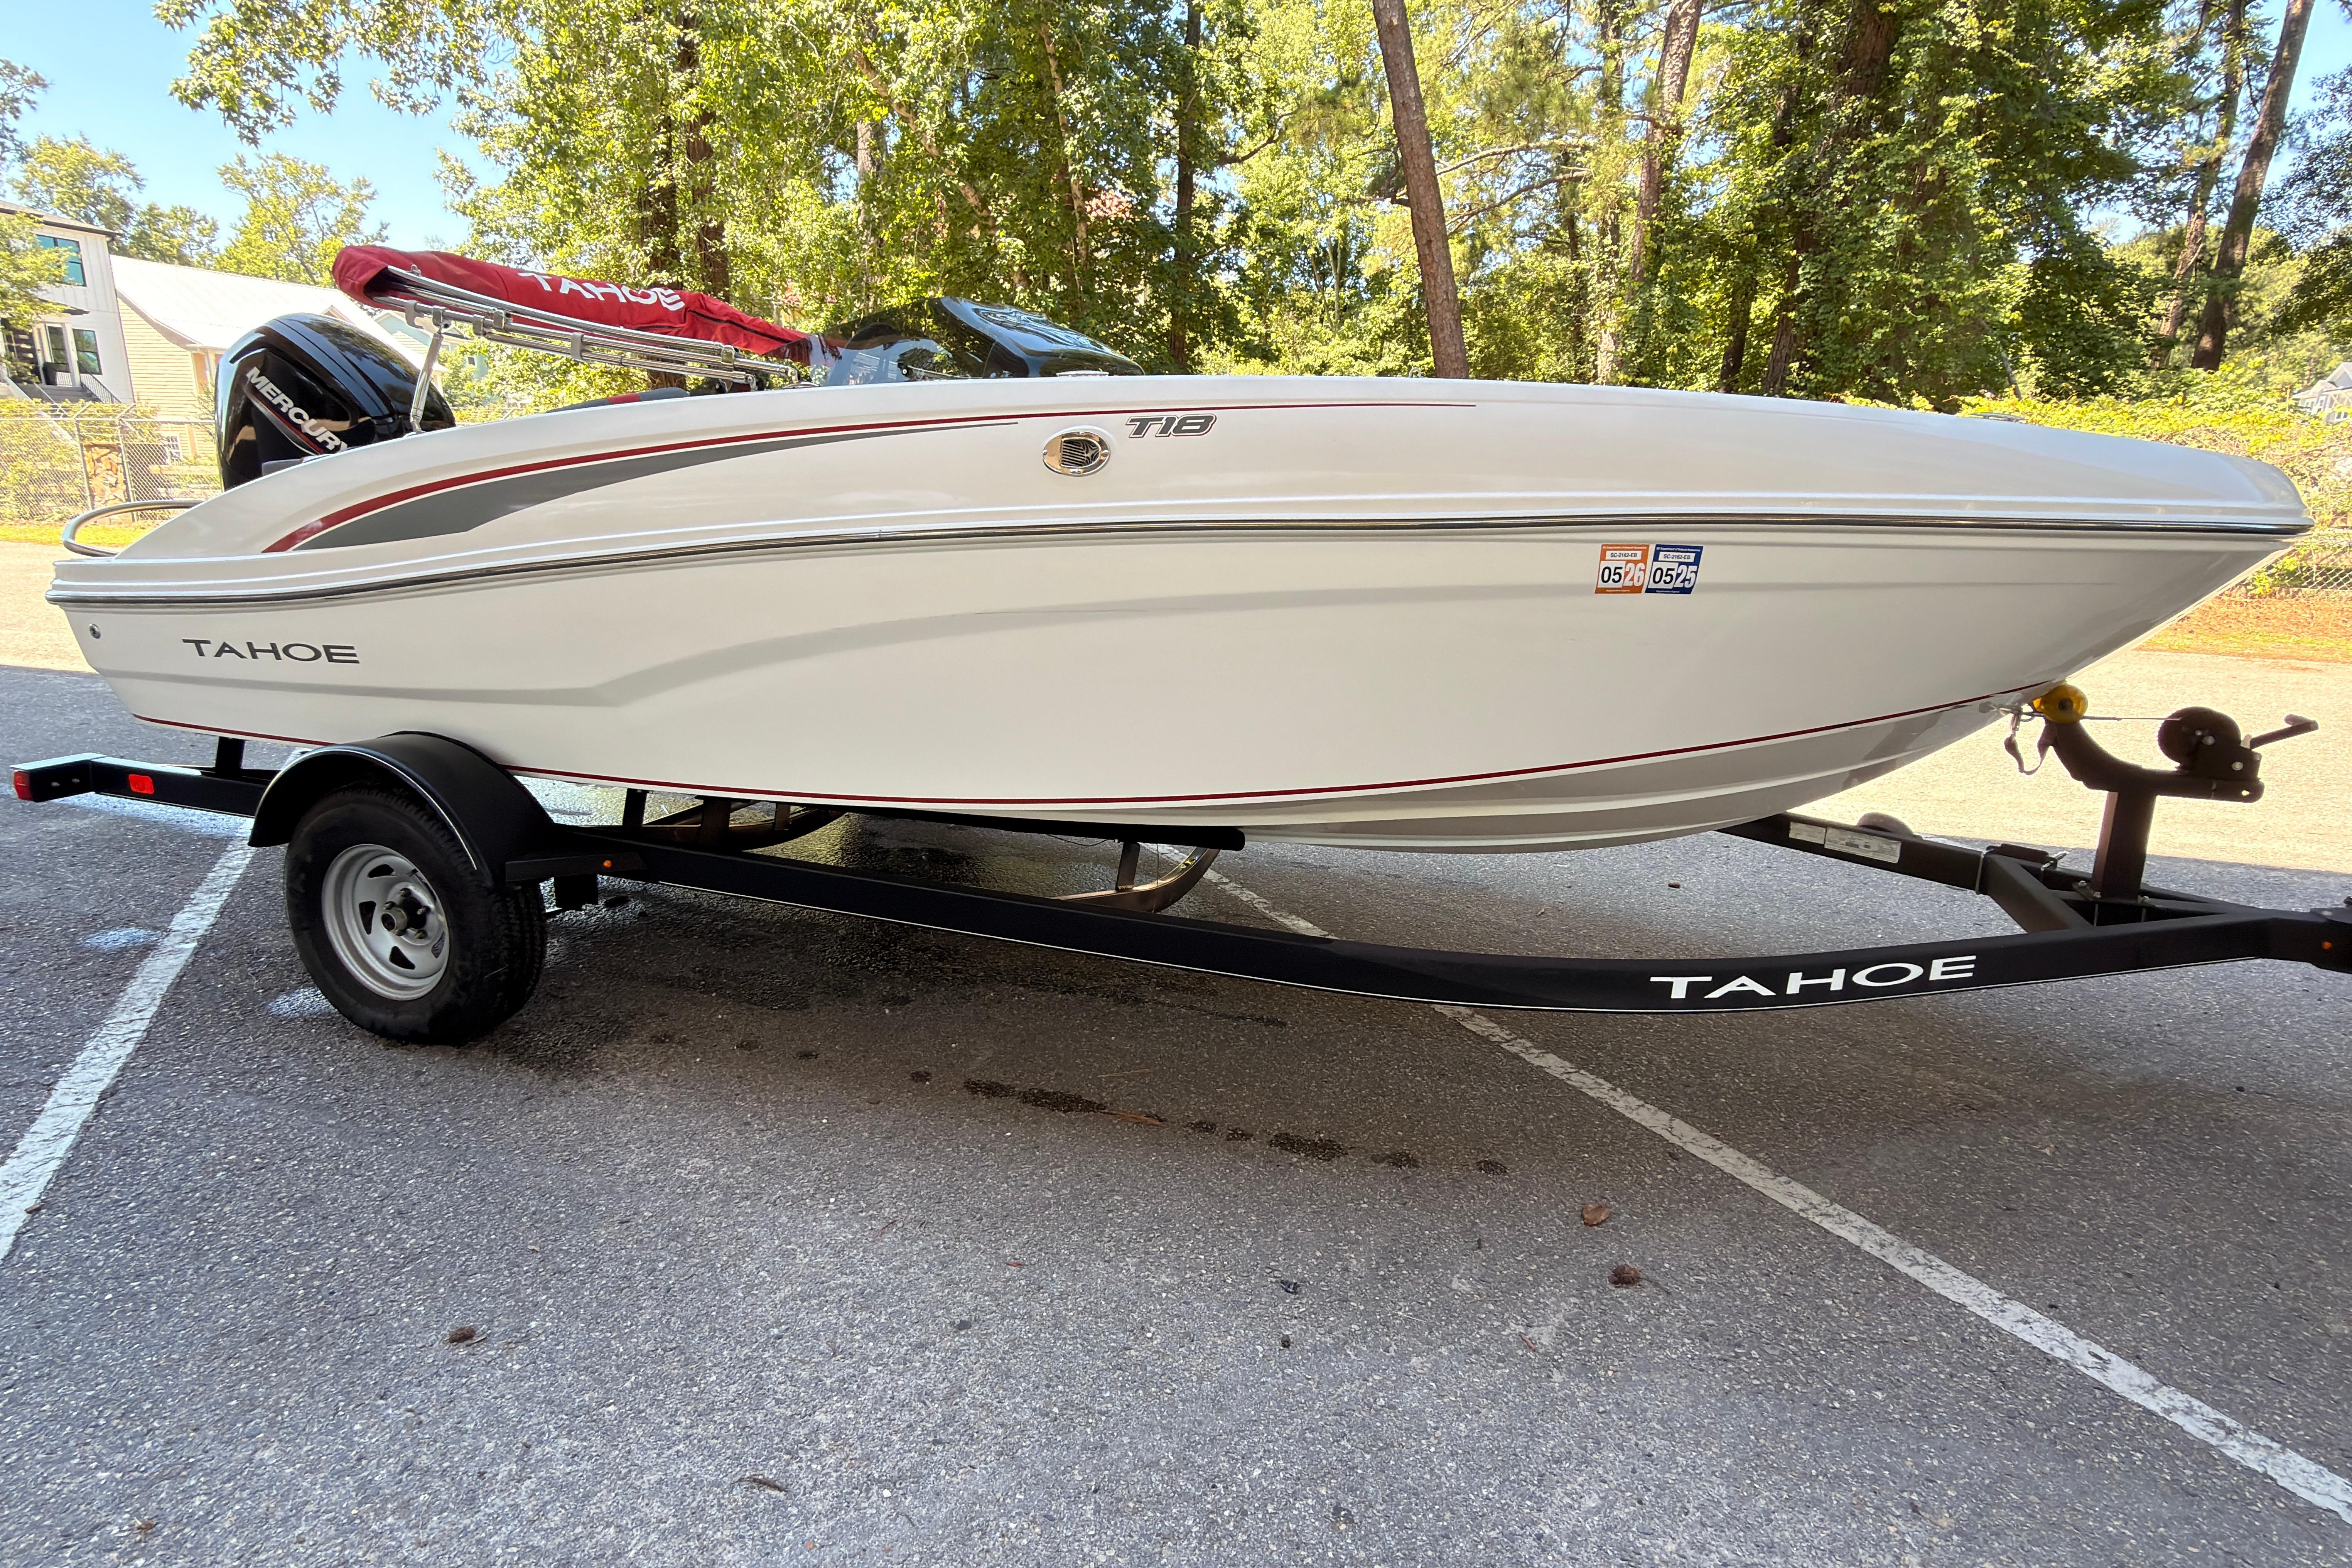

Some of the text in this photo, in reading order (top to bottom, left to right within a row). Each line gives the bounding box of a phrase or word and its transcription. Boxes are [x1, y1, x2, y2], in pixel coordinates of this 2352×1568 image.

[518, 272, 685, 311] TAHOE
[1125, 414, 1217, 438] T18
[182, 639, 360, 664] TAHOE
[1649, 955, 1976, 999] TAHOE
